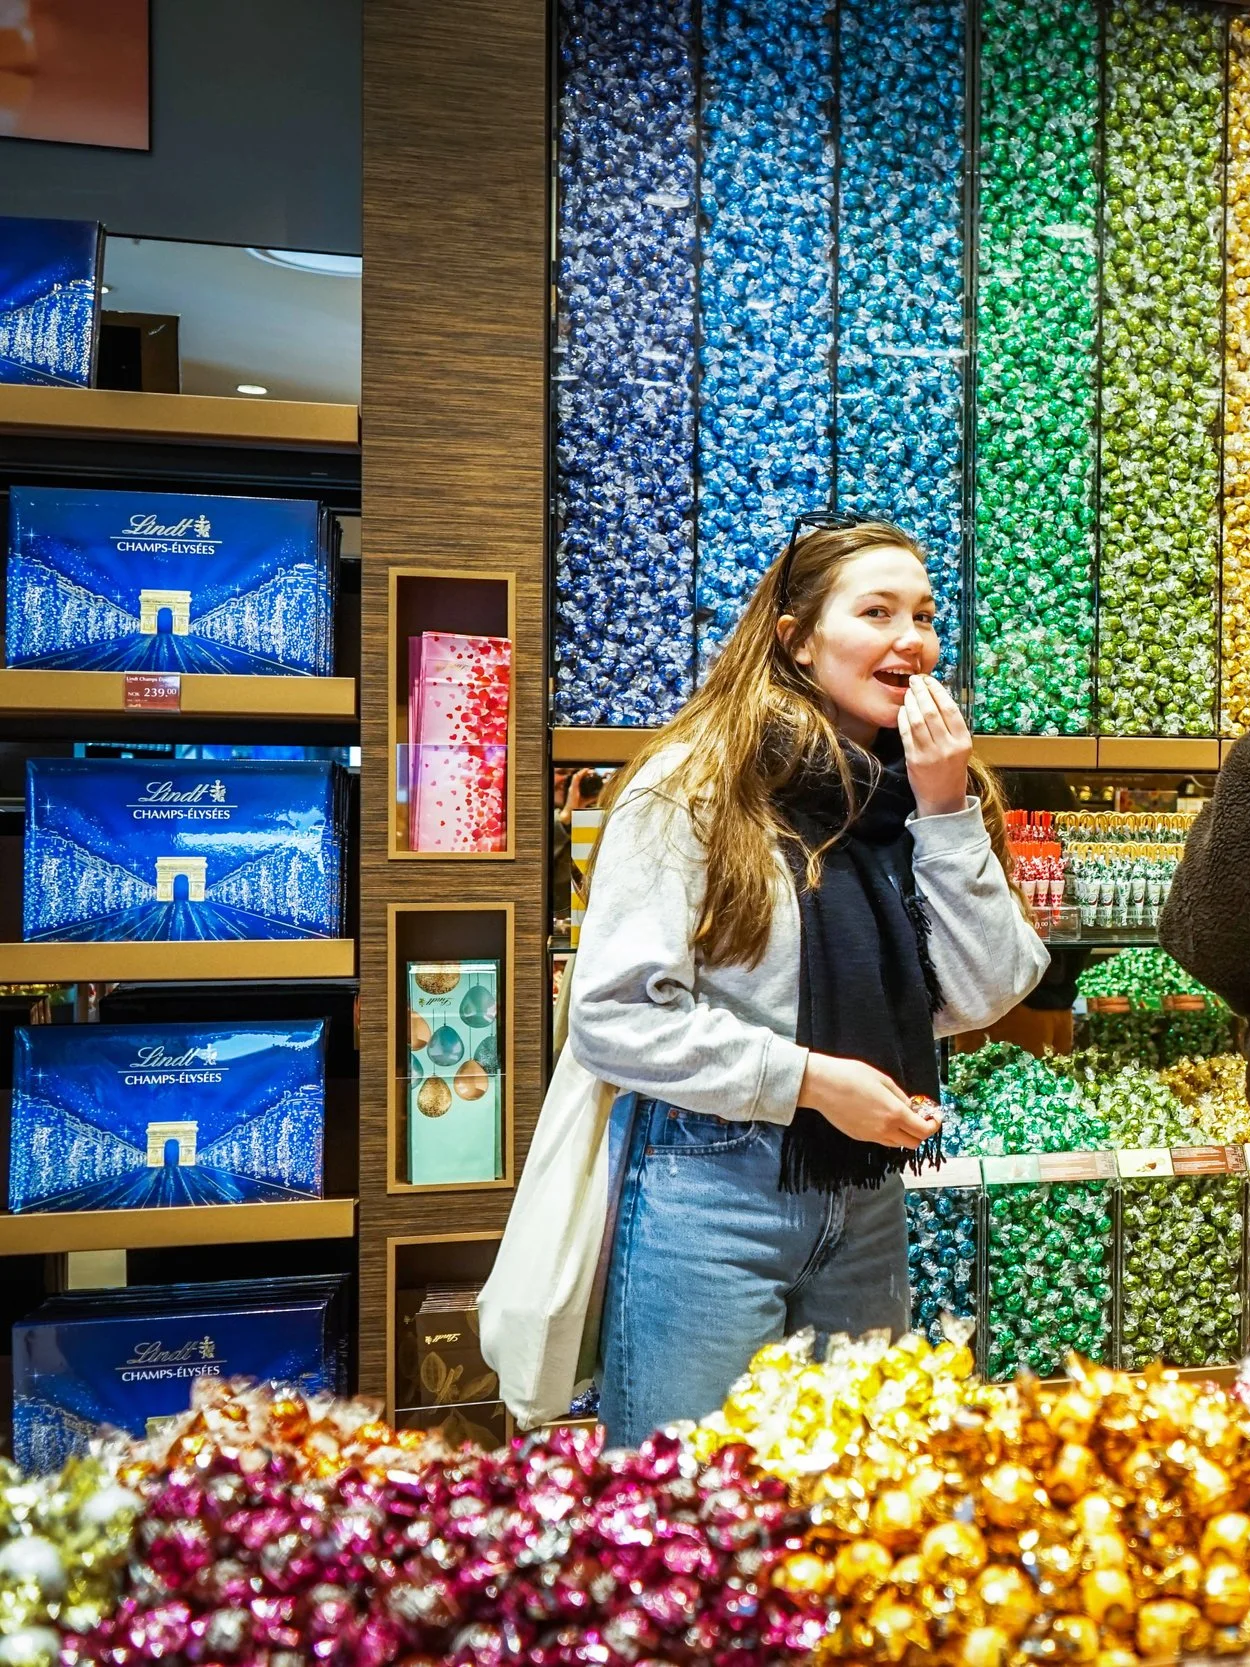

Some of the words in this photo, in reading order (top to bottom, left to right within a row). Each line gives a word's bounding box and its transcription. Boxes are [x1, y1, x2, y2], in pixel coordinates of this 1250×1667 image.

[121, 513, 195, 537] Lindt
[116, 540, 215, 555] CHAMPS-ÉLYSÉES
[137, 780, 211, 803] Lindt
[132, 808, 231, 820] CHAMPS-ÉLYSÉES
[128, 1045, 200, 1069] Lindt
[124, 1071, 222, 1086] CHAMPS-ÉLYSÉES
[126, 1340, 200, 1364] Lindt
[121, 1365, 220, 1382] CHAMPS-ÉLYSÉES
